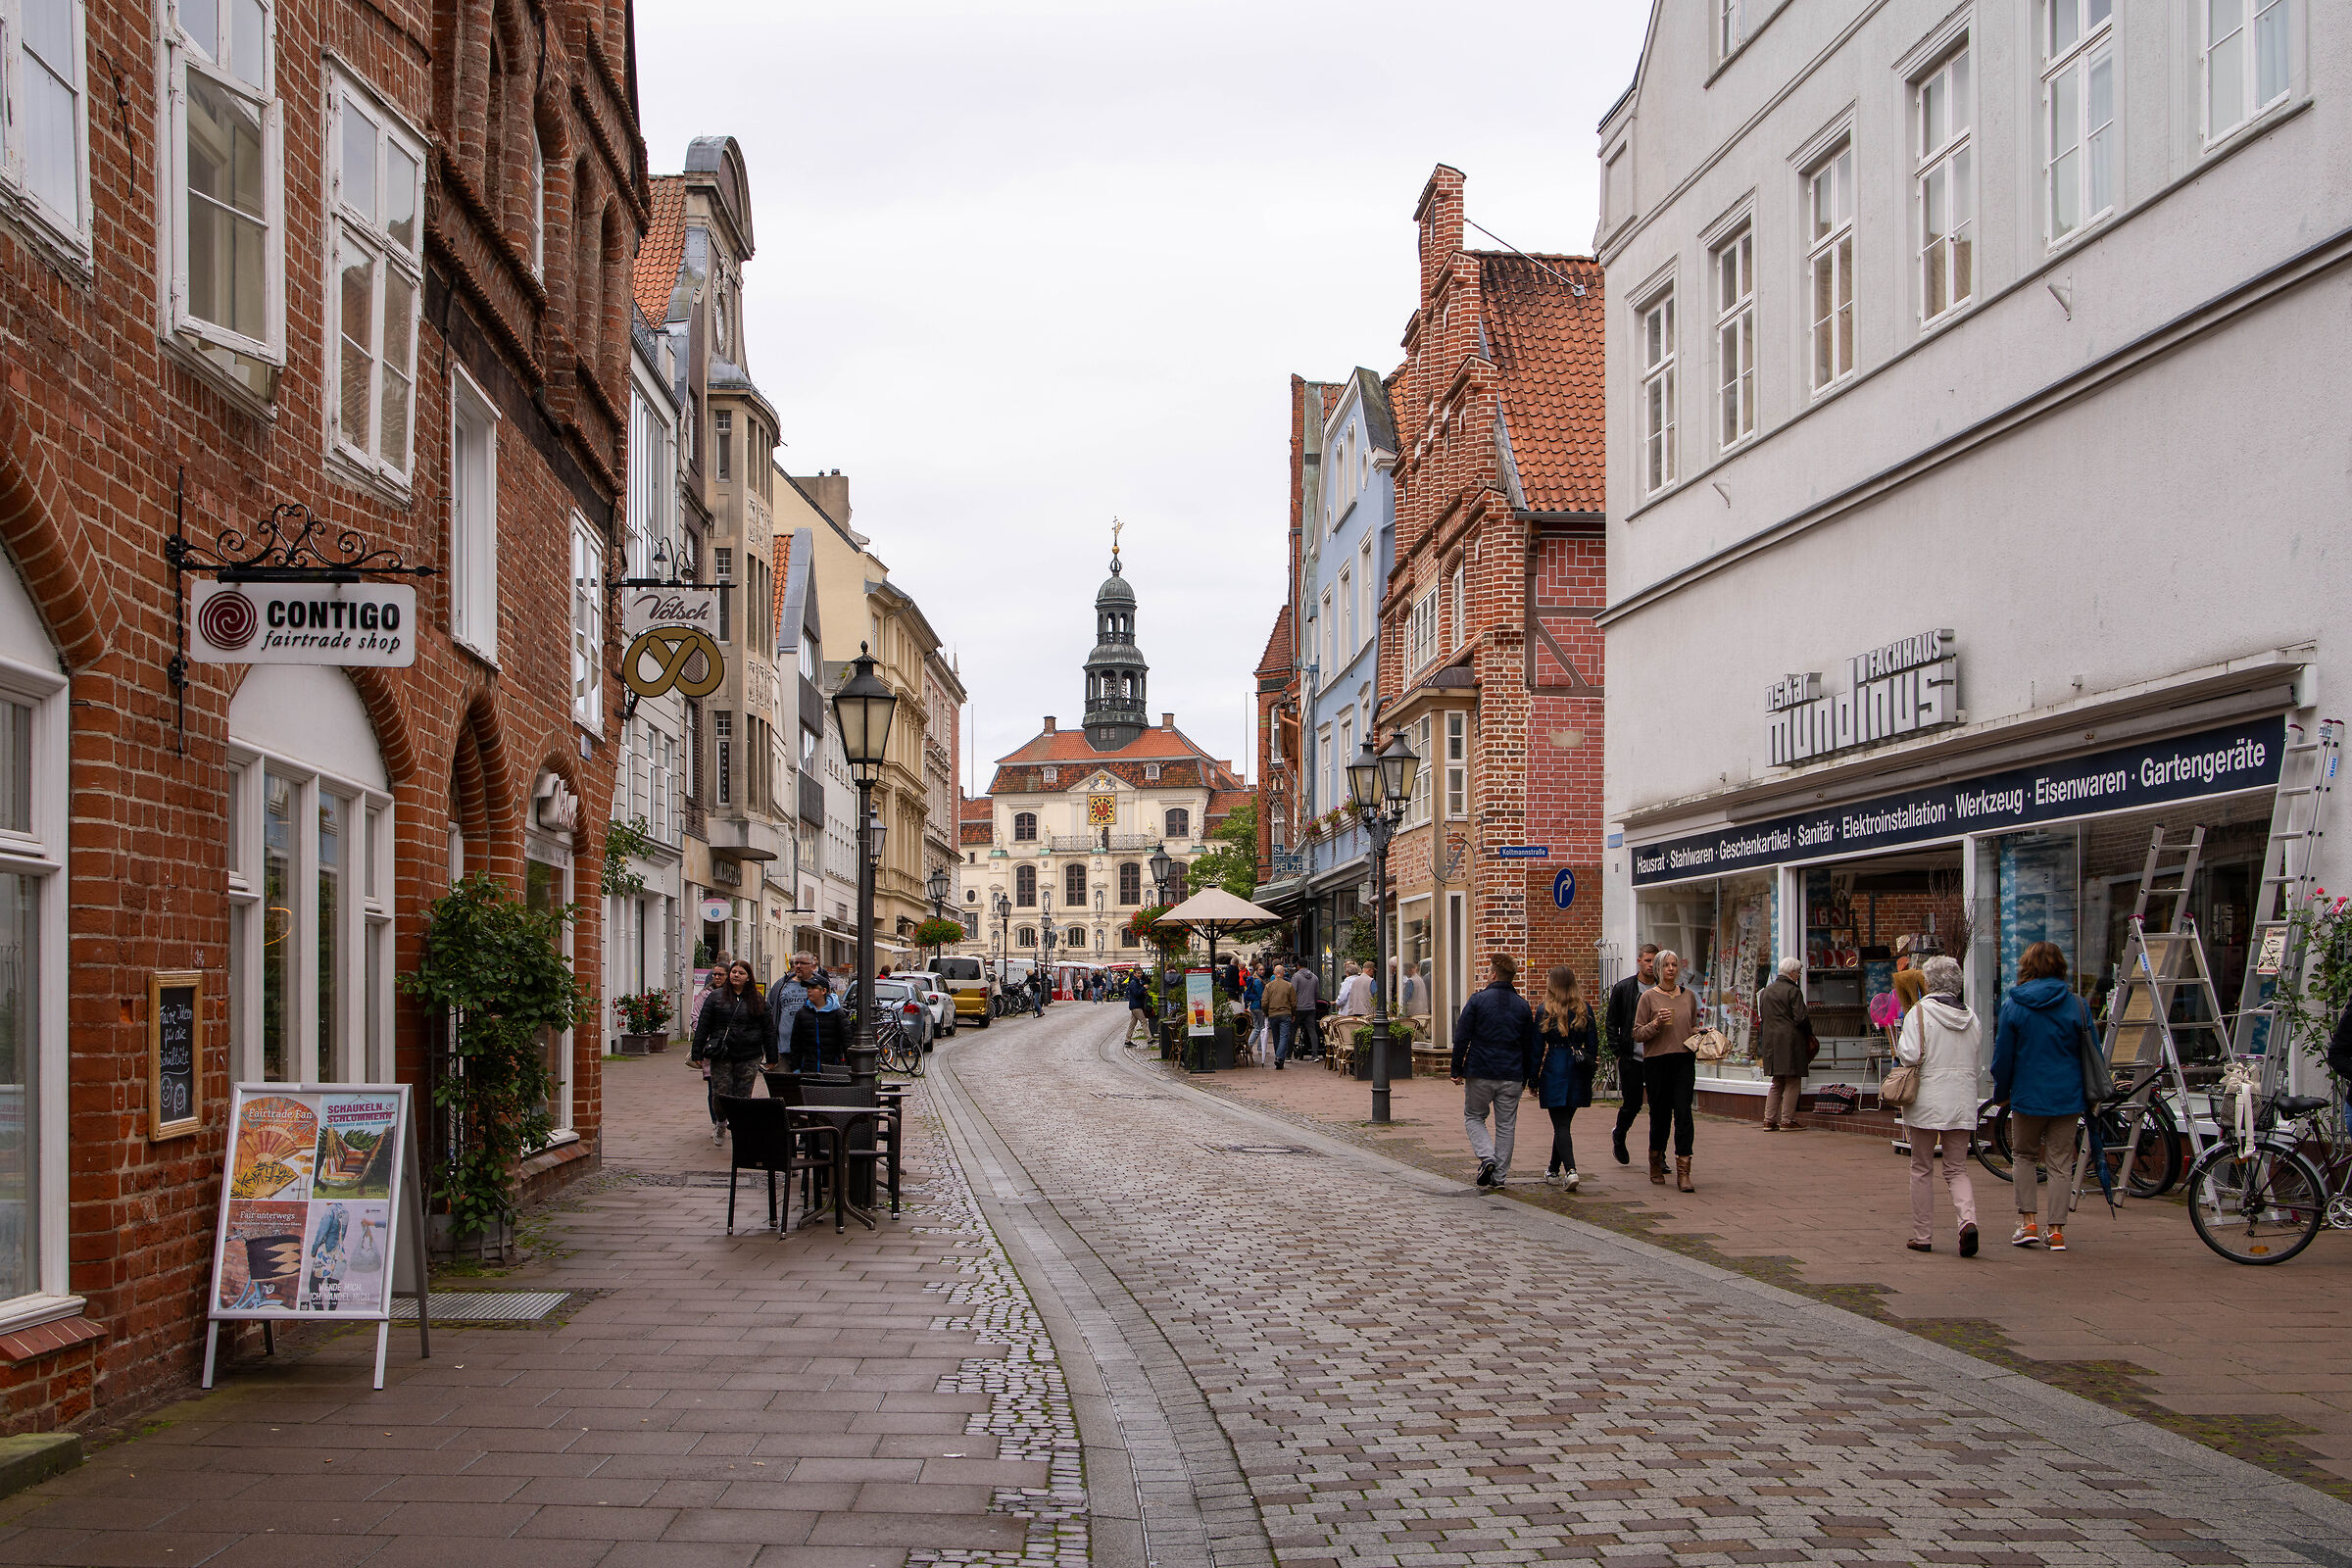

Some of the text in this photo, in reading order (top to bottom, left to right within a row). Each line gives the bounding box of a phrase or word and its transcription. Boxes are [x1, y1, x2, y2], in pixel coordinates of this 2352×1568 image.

[633, 594, 710, 622] Völsch
[268, 599, 401, 630] CONTIGO
[261, 630, 402, 654] fairtrade shop
[1868, 628, 1944, 678] FACHHAUS
[1636, 737, 2266, 874] Hausrat Stahlwaren Geschenkartikel Sanitär Elektroinstallation Werkzeug Eisenwaren Gartengeräte
[1275, 862, 1302, 872] PELZE
[175, 1028, 187, 1040] die
[249, 1108, 313, 1119] Fairtrade Fan
[327, 1102, 383, 1114] SCHAUKELN
[326, 1112, 393, 1123] SCHLUMMERN
[240, 1210, 296, 1221] Fair unterwegs
